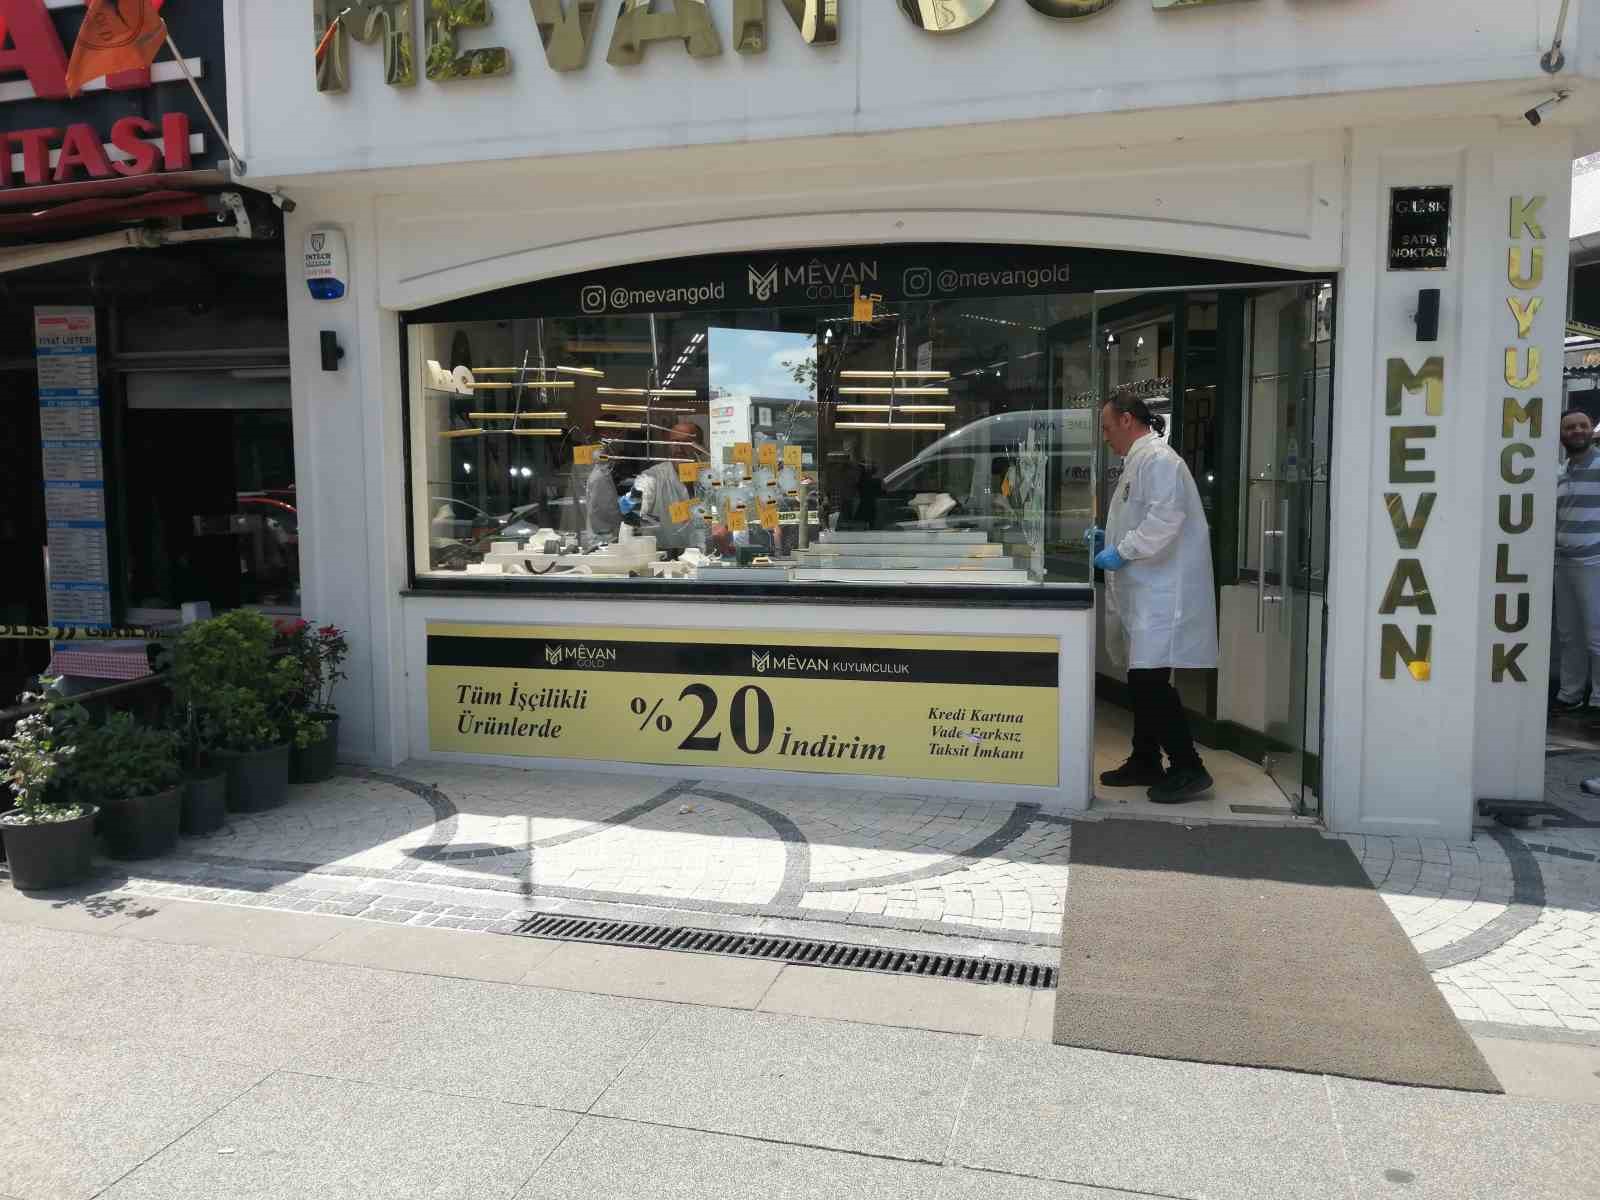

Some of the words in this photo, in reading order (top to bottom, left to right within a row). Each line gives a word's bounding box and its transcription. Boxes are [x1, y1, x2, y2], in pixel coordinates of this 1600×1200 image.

[0, 112, 192, 187] TASI
[784, 257, 879, 287] MÊVAN
[937, 264, 1070, 292] @mevangold
[610, 281, 726, 308] @mevangold
[1492, 196, 1547, 683] KUYUMCULUK
[1380, 357, 1444, 681] MEVAN
[565, 644, 616, 660] MÊVAN
[576, 659, 606, 668] GOLD
[773, 654, 829, 671] MÊVAN
[832, 662, 911, 675] KUYUMCULUK
[457, 684, 502, 706] Tüm
[508, 681, 588, 711] İşçilikli
[457, 710, 562, 738] Ürünlerde
[630, 683, 775, 755] %20
[776, 726, 887, 760] İndirim
[928, 707, 967, 721] Kredi
[970, 709, 1024, 723] Kartına
[932, 725, 961, 739] Vade
[929, 743, 969, 757] Taksit
[973, 743, 1025, 760] İmkanı
